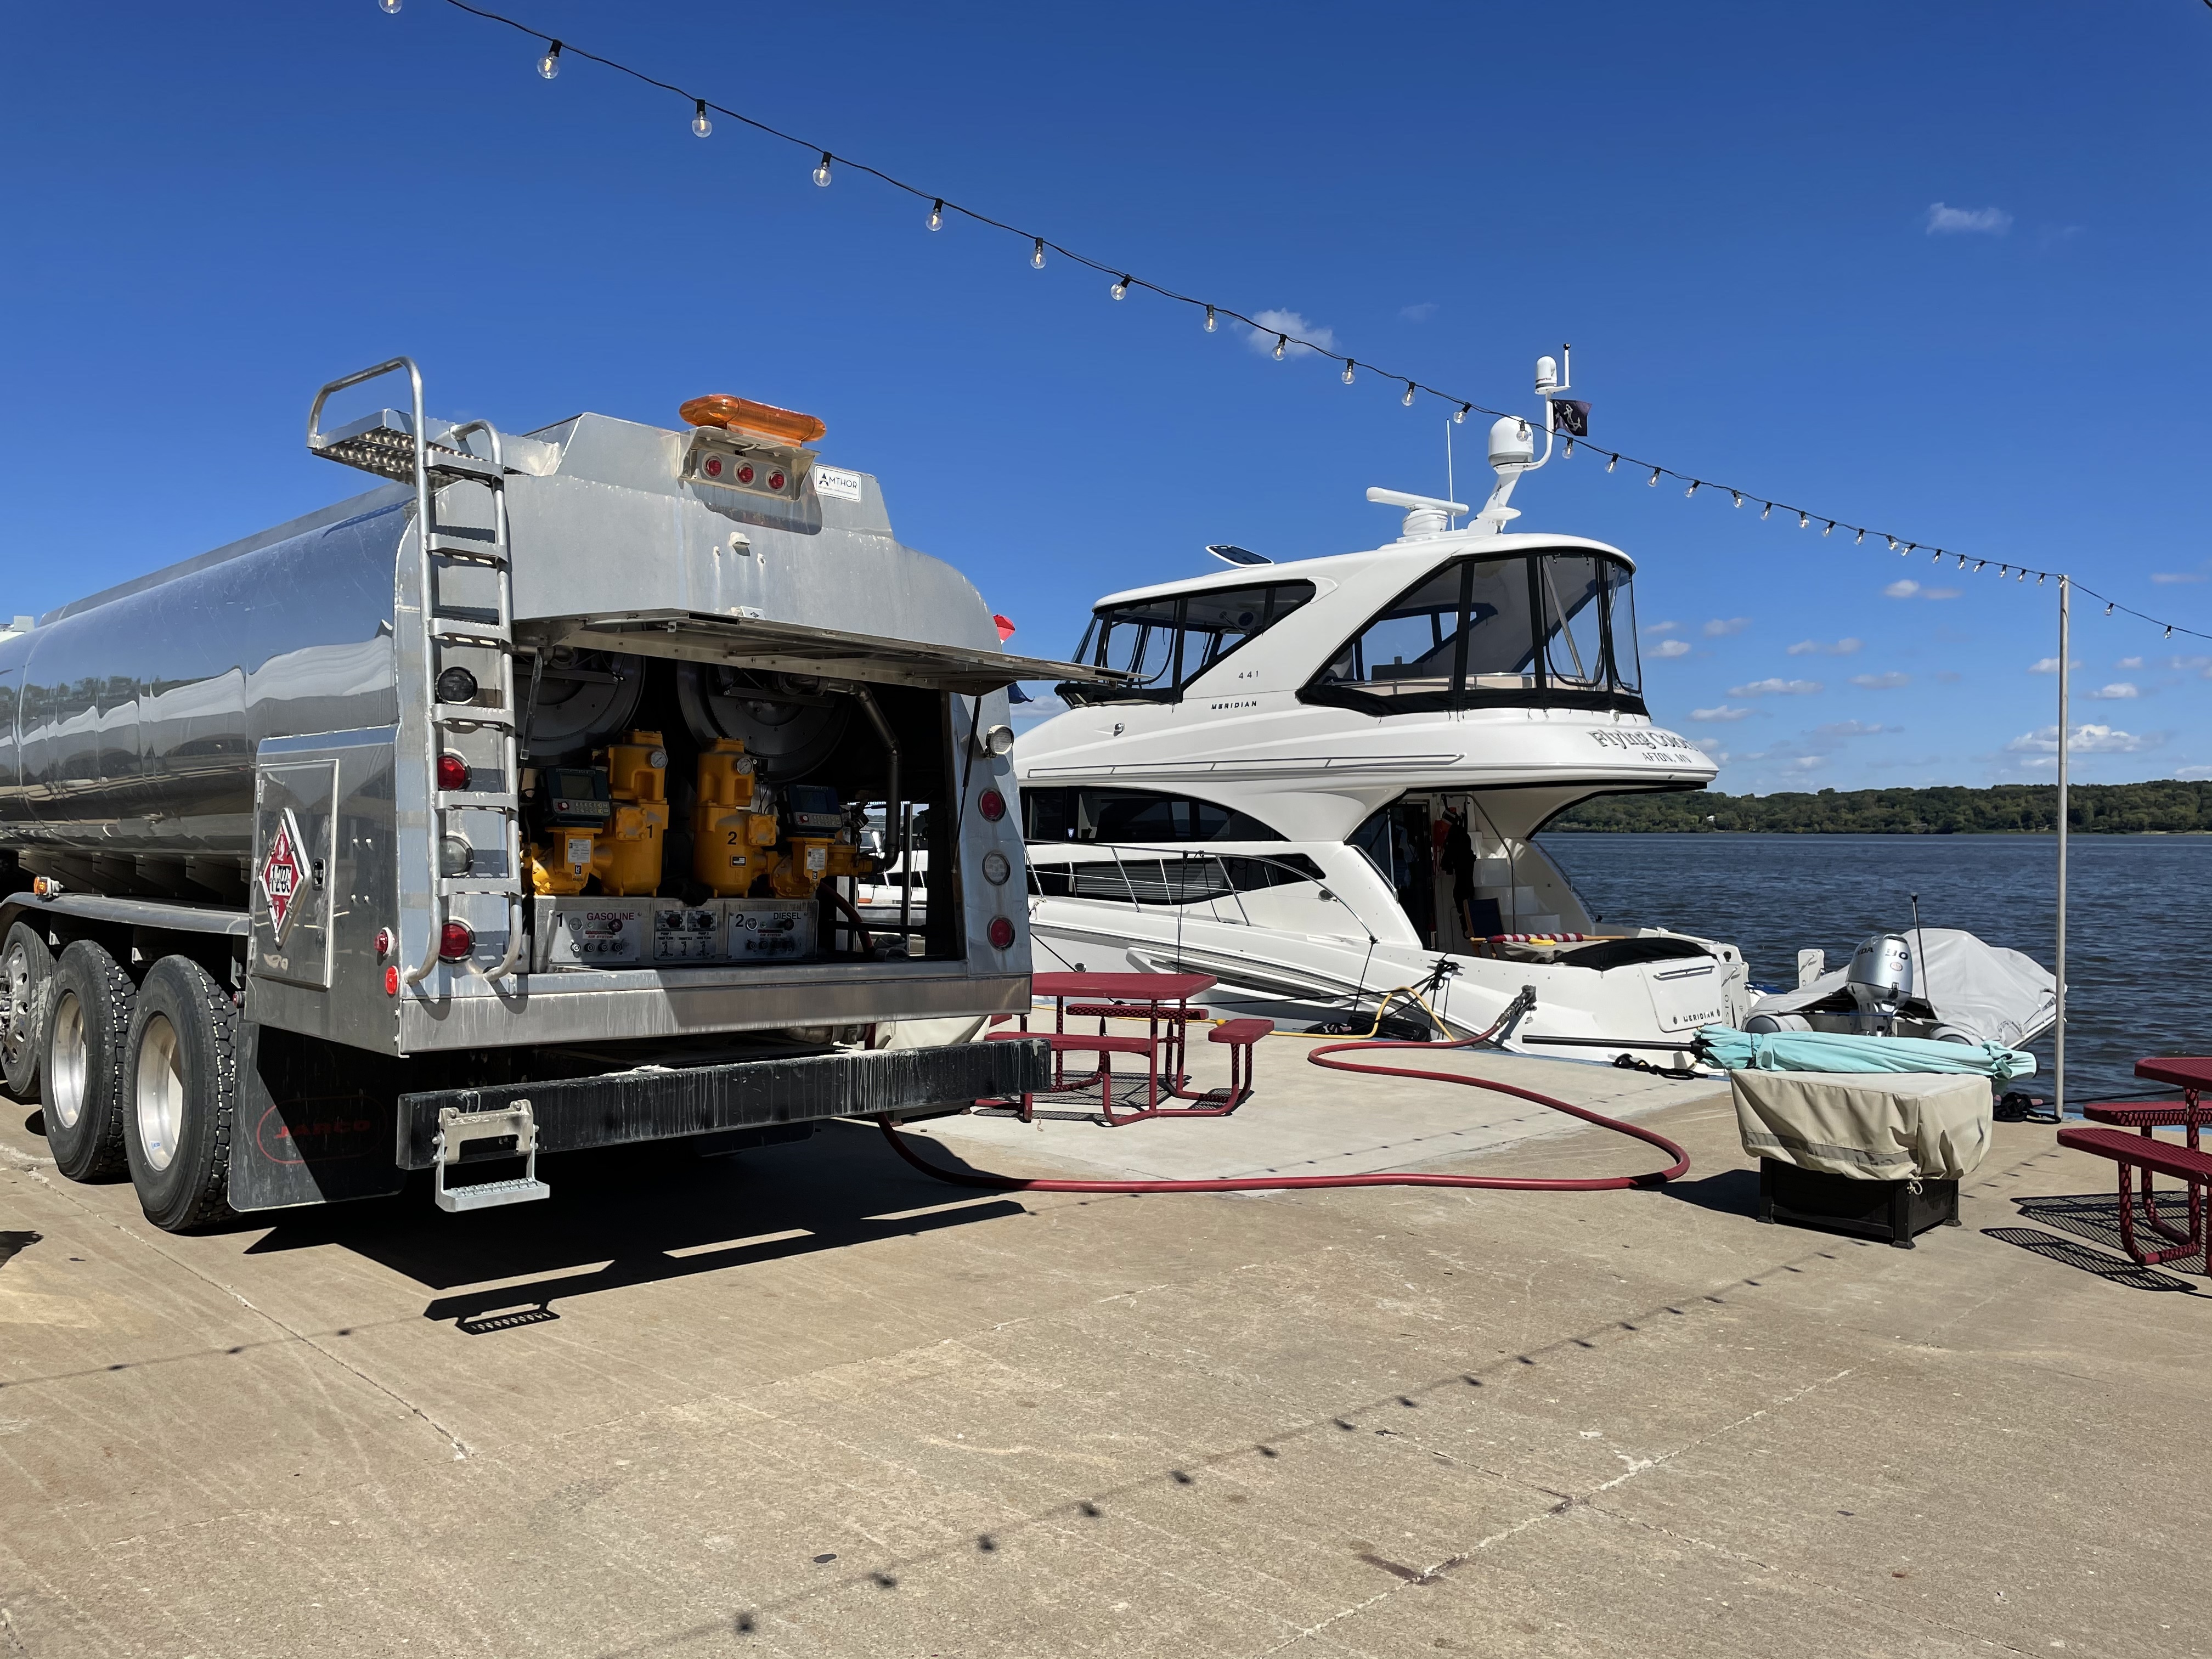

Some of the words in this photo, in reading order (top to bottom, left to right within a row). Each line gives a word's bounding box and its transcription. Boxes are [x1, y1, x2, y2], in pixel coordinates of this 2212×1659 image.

[819, 473, 857, 489] AMTHOR
[1238, 670, 1259, 679] 441
[1211, 701, 1257, 709] MERIDIAN
[1586, 729, 1656, 749] Flying
[1642, 752, 1677, 763] AFTON,
[1675, 754, 1692, 763] MN
[647, 824, 653, 838] 1
[727, 831, 737, 845] 2
[556, 912, 563, 927] 1
[586, 912, 635, 921] GASOLINE
[735, 913, 744, 927] 2
[1683, 1011, 1714, 1023] MERIDIAN
[274, 1120, 371, 1138] JARCO
